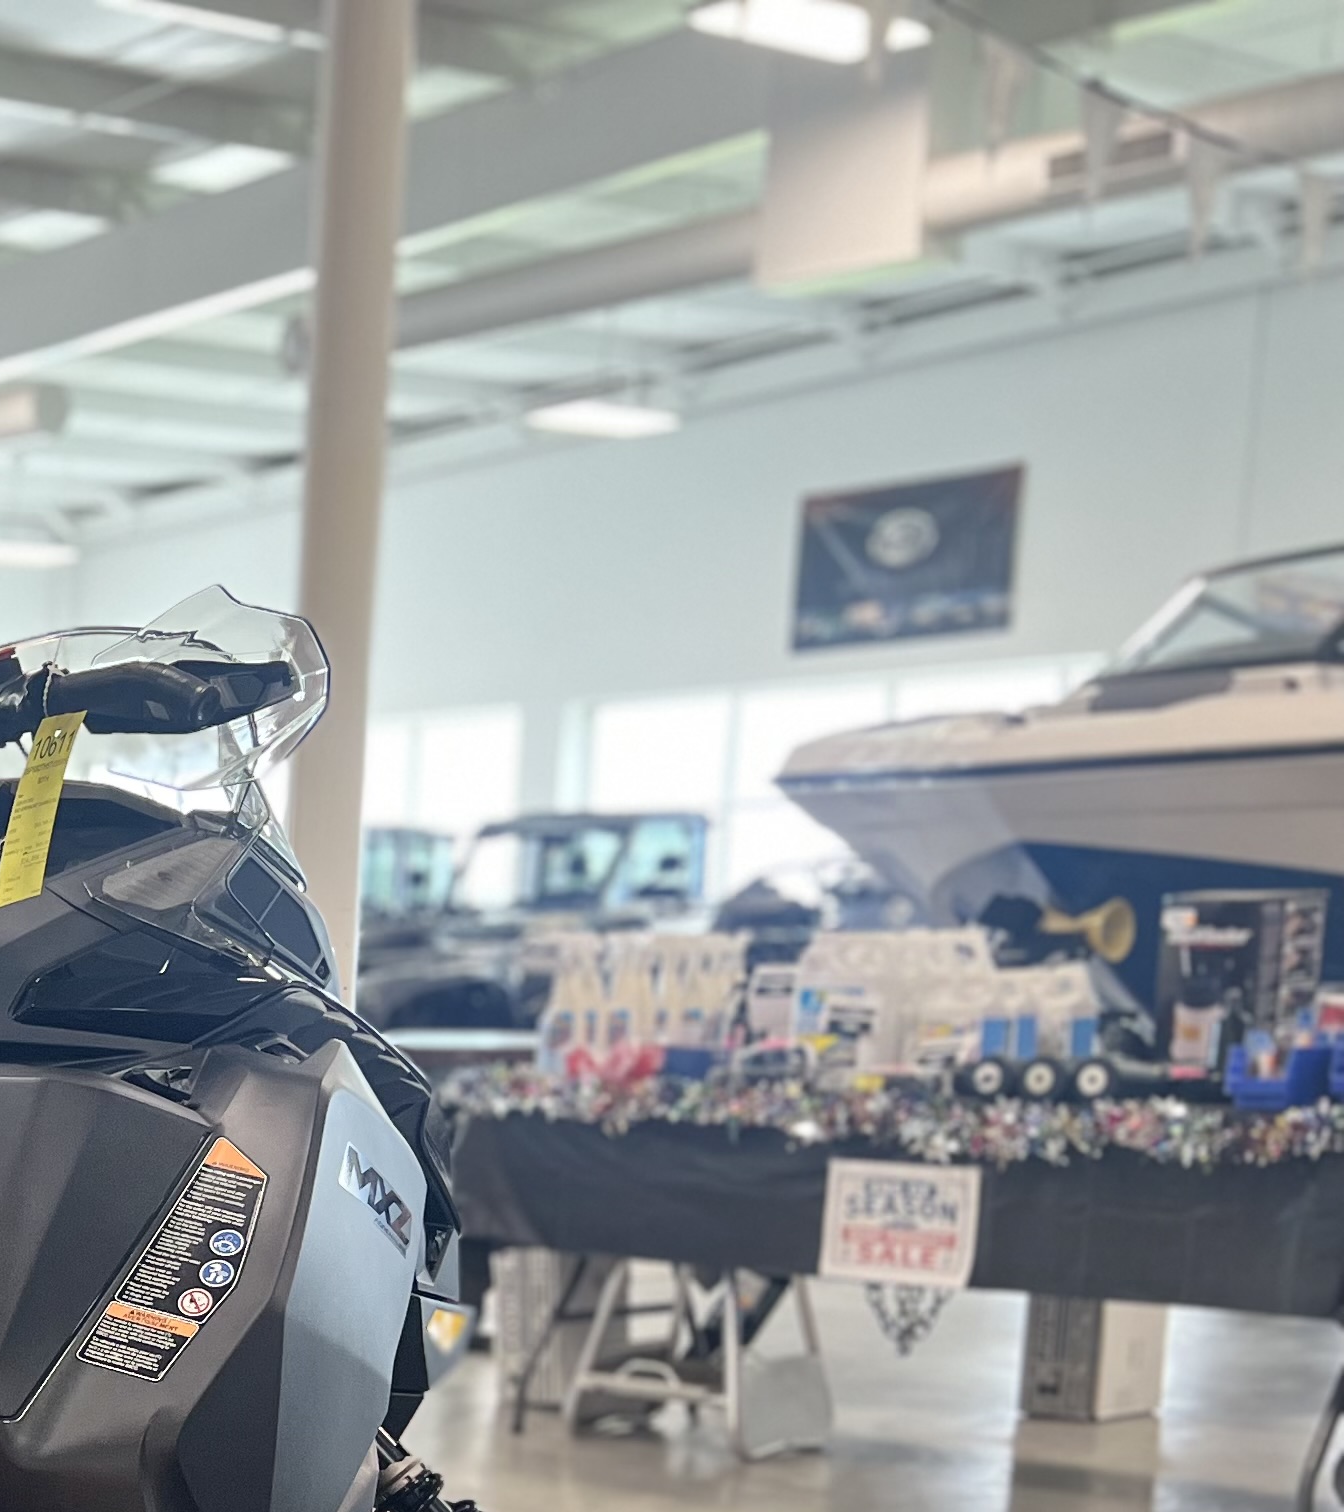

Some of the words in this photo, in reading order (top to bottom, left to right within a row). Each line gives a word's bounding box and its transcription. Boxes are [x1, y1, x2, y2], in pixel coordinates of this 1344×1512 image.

[33, 730, 77, 761] 10611
[845, 1193, 958, 1225] SEASON
[857, 1242, 938, 1270] SALE
